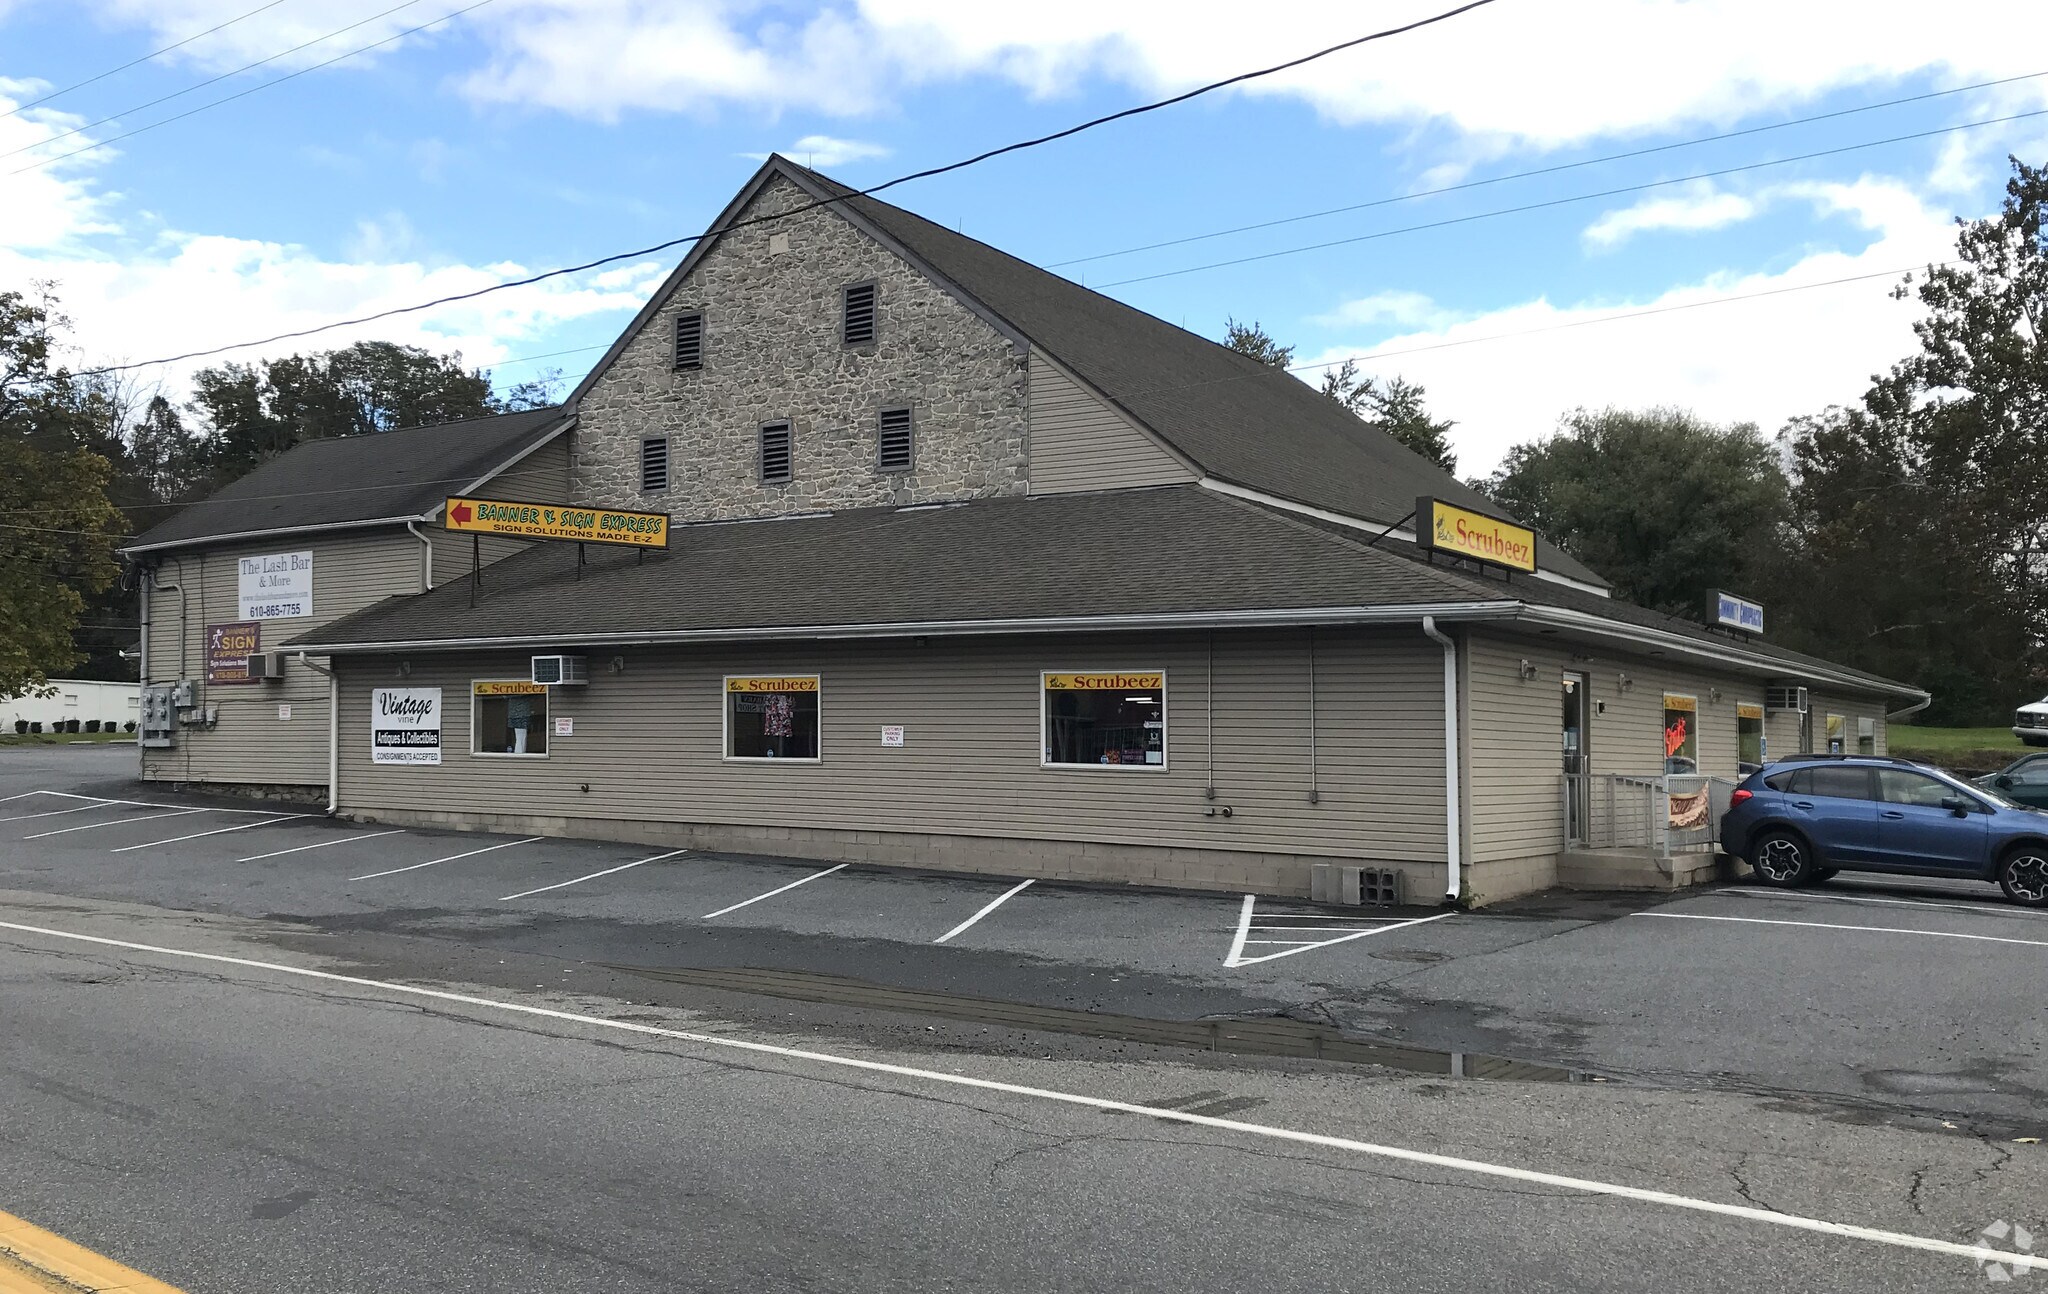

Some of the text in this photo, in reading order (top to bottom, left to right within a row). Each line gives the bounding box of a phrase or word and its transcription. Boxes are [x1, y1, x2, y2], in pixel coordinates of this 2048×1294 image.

[478, 504, 662, 534] BANNER & SIGN EXPRESS
[493, 524, 653, 543] SIGN SOLUTIONS MADE E-Z
[1456, 518, 1529, 563] Scrubeez
[241, 554, 310, 575] The Lash Bar
[260, 575, 291, 588] & More
[250, 603, 301, 618] 610-865-7755
[222, 636, 255, 649] SIGN
[749, 679, 816, 691] Scrubeez
[1074, 675, 1160, 688] Scrubeez
[492, 683, 545, 694] Scrubeez
[379, 692, 432, 724] Vintage
[398, 716, 414, 724] vine
[377, 732, 438, 746] Antiques & Collectibles
[377, 752, 438, 760] CONSIGNMENTS ACCEPTED
